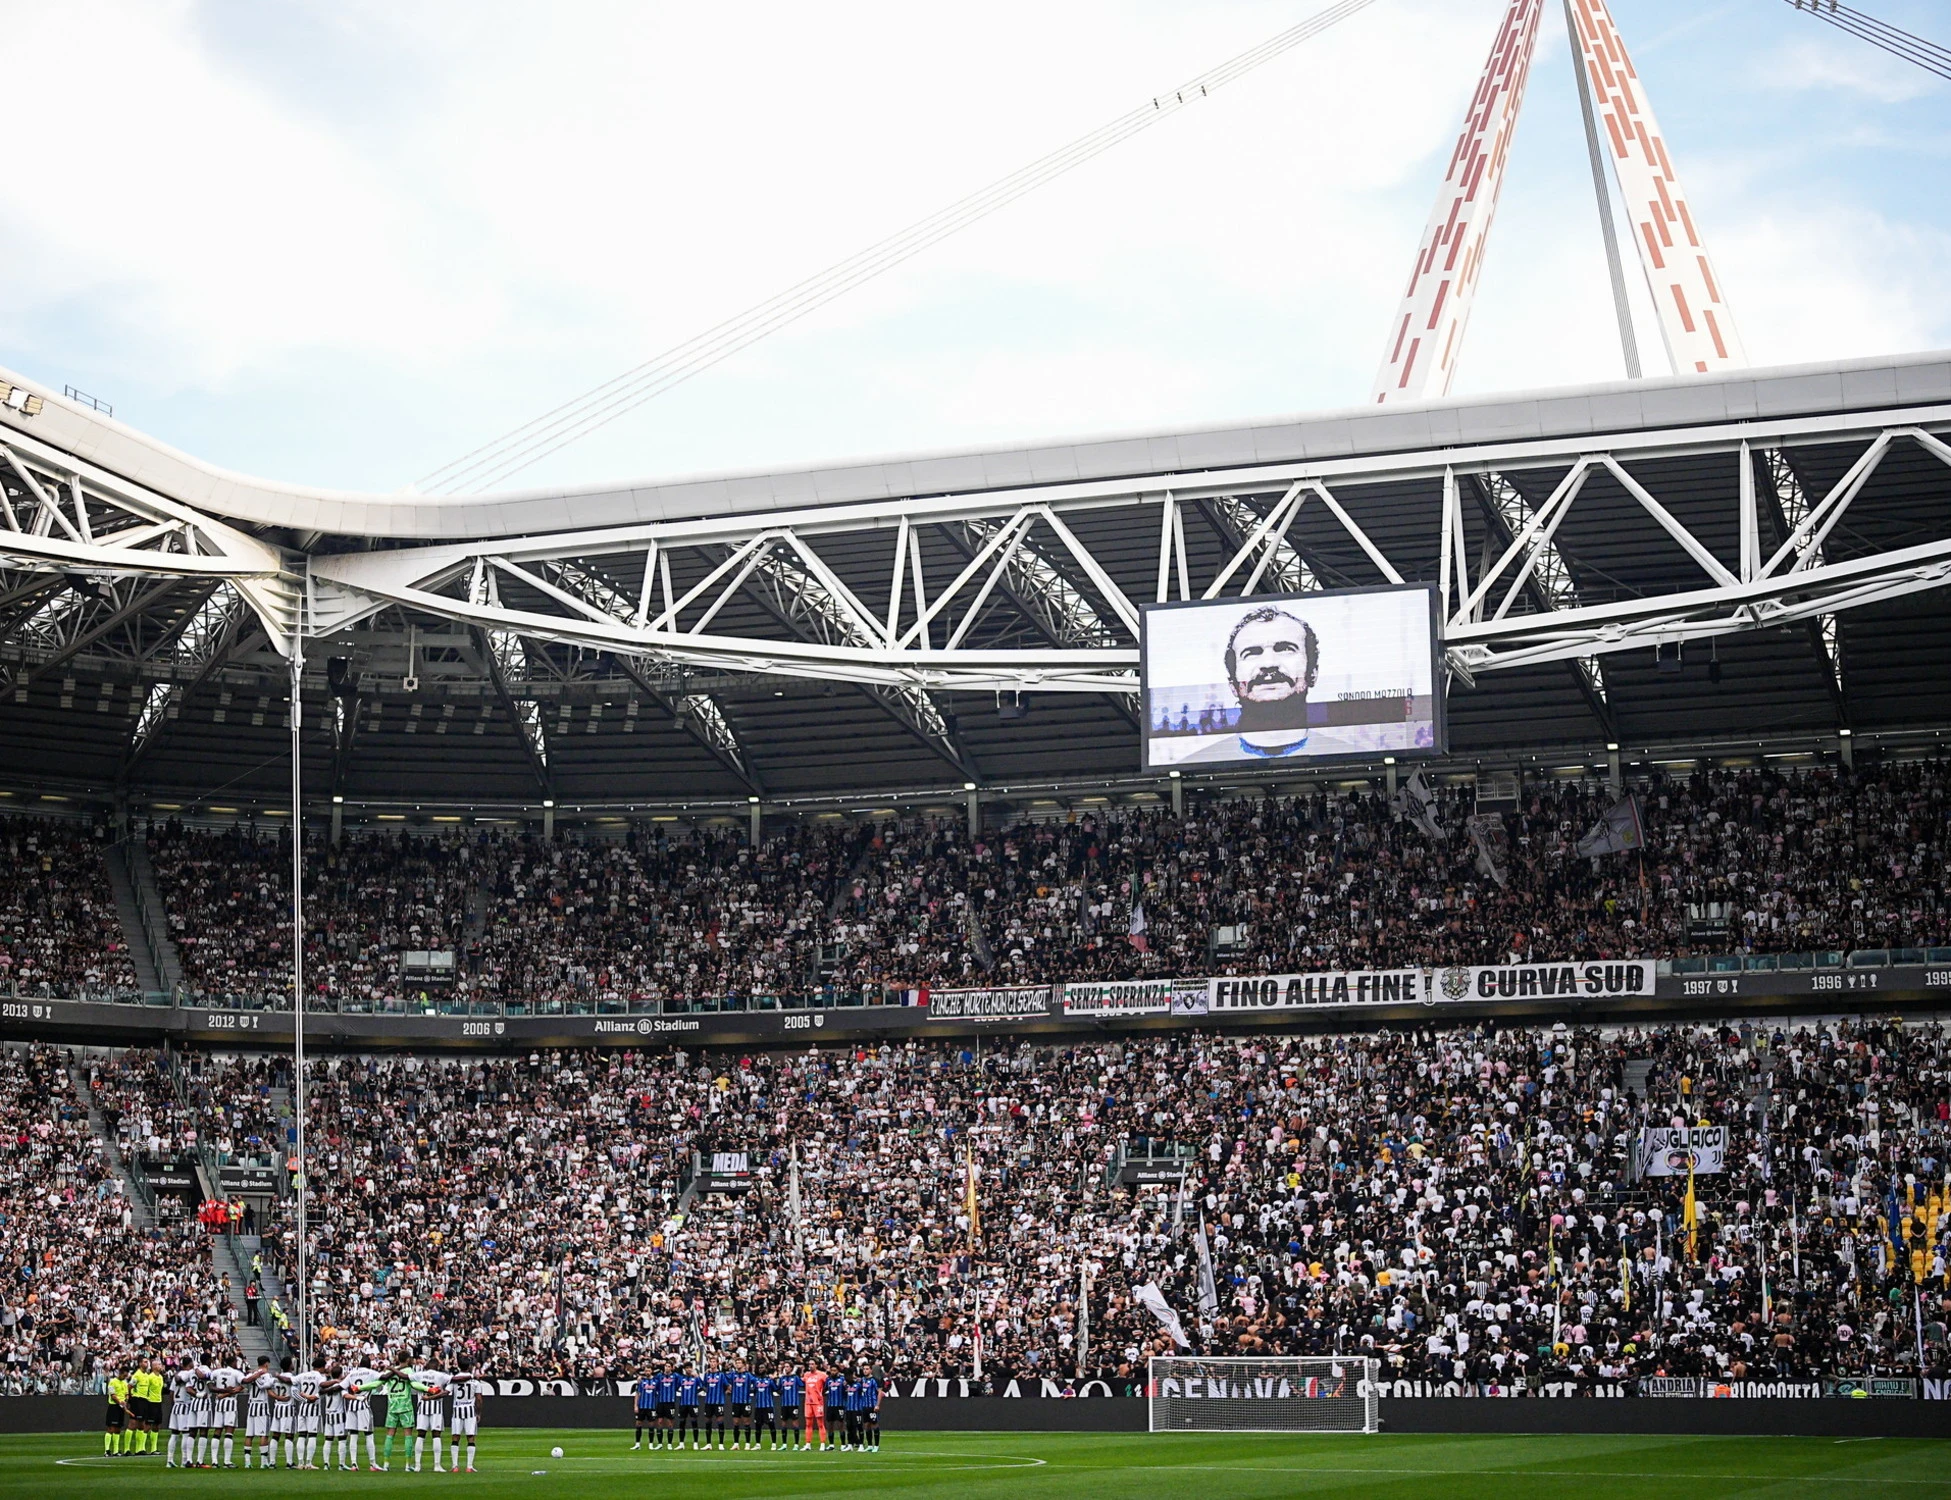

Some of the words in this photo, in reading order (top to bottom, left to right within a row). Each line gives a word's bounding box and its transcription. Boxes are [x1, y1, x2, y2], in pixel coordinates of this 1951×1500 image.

[1477, 967, 1578, 998] CURVA
[1584, 964, 1644, 994] SUD
[1683, 981, 1712, 995] 1997
[1811, 975, 1842, 990] 1996
[1069, 986, 1103, 1010] SENZA
[1108, 983, 1165, 1010] SPERANZA
[1216, 980, 1278, 1007] FINO
[1285, 976, 1350, 1004] ALLA
[1358, 973, 1416, 1002] FINE
[2, 1003, 28, 1017] 2013
[208, 1014, 235, 1028] 2012
[594, 1020, 635, 1032] Allianz
[654, 1020, 699, 1031] Stadium
[784, 1016, 810, 1029] 2005
[463, 1022, 490, 1035] 2006
[712, 1152, 748, 1172] MEDA
[1841, 1329, 1848, 1337] 10
[457, 1383, 471, 1400] 31
[1652, 1379, 1694, 1392] ANDRIA
